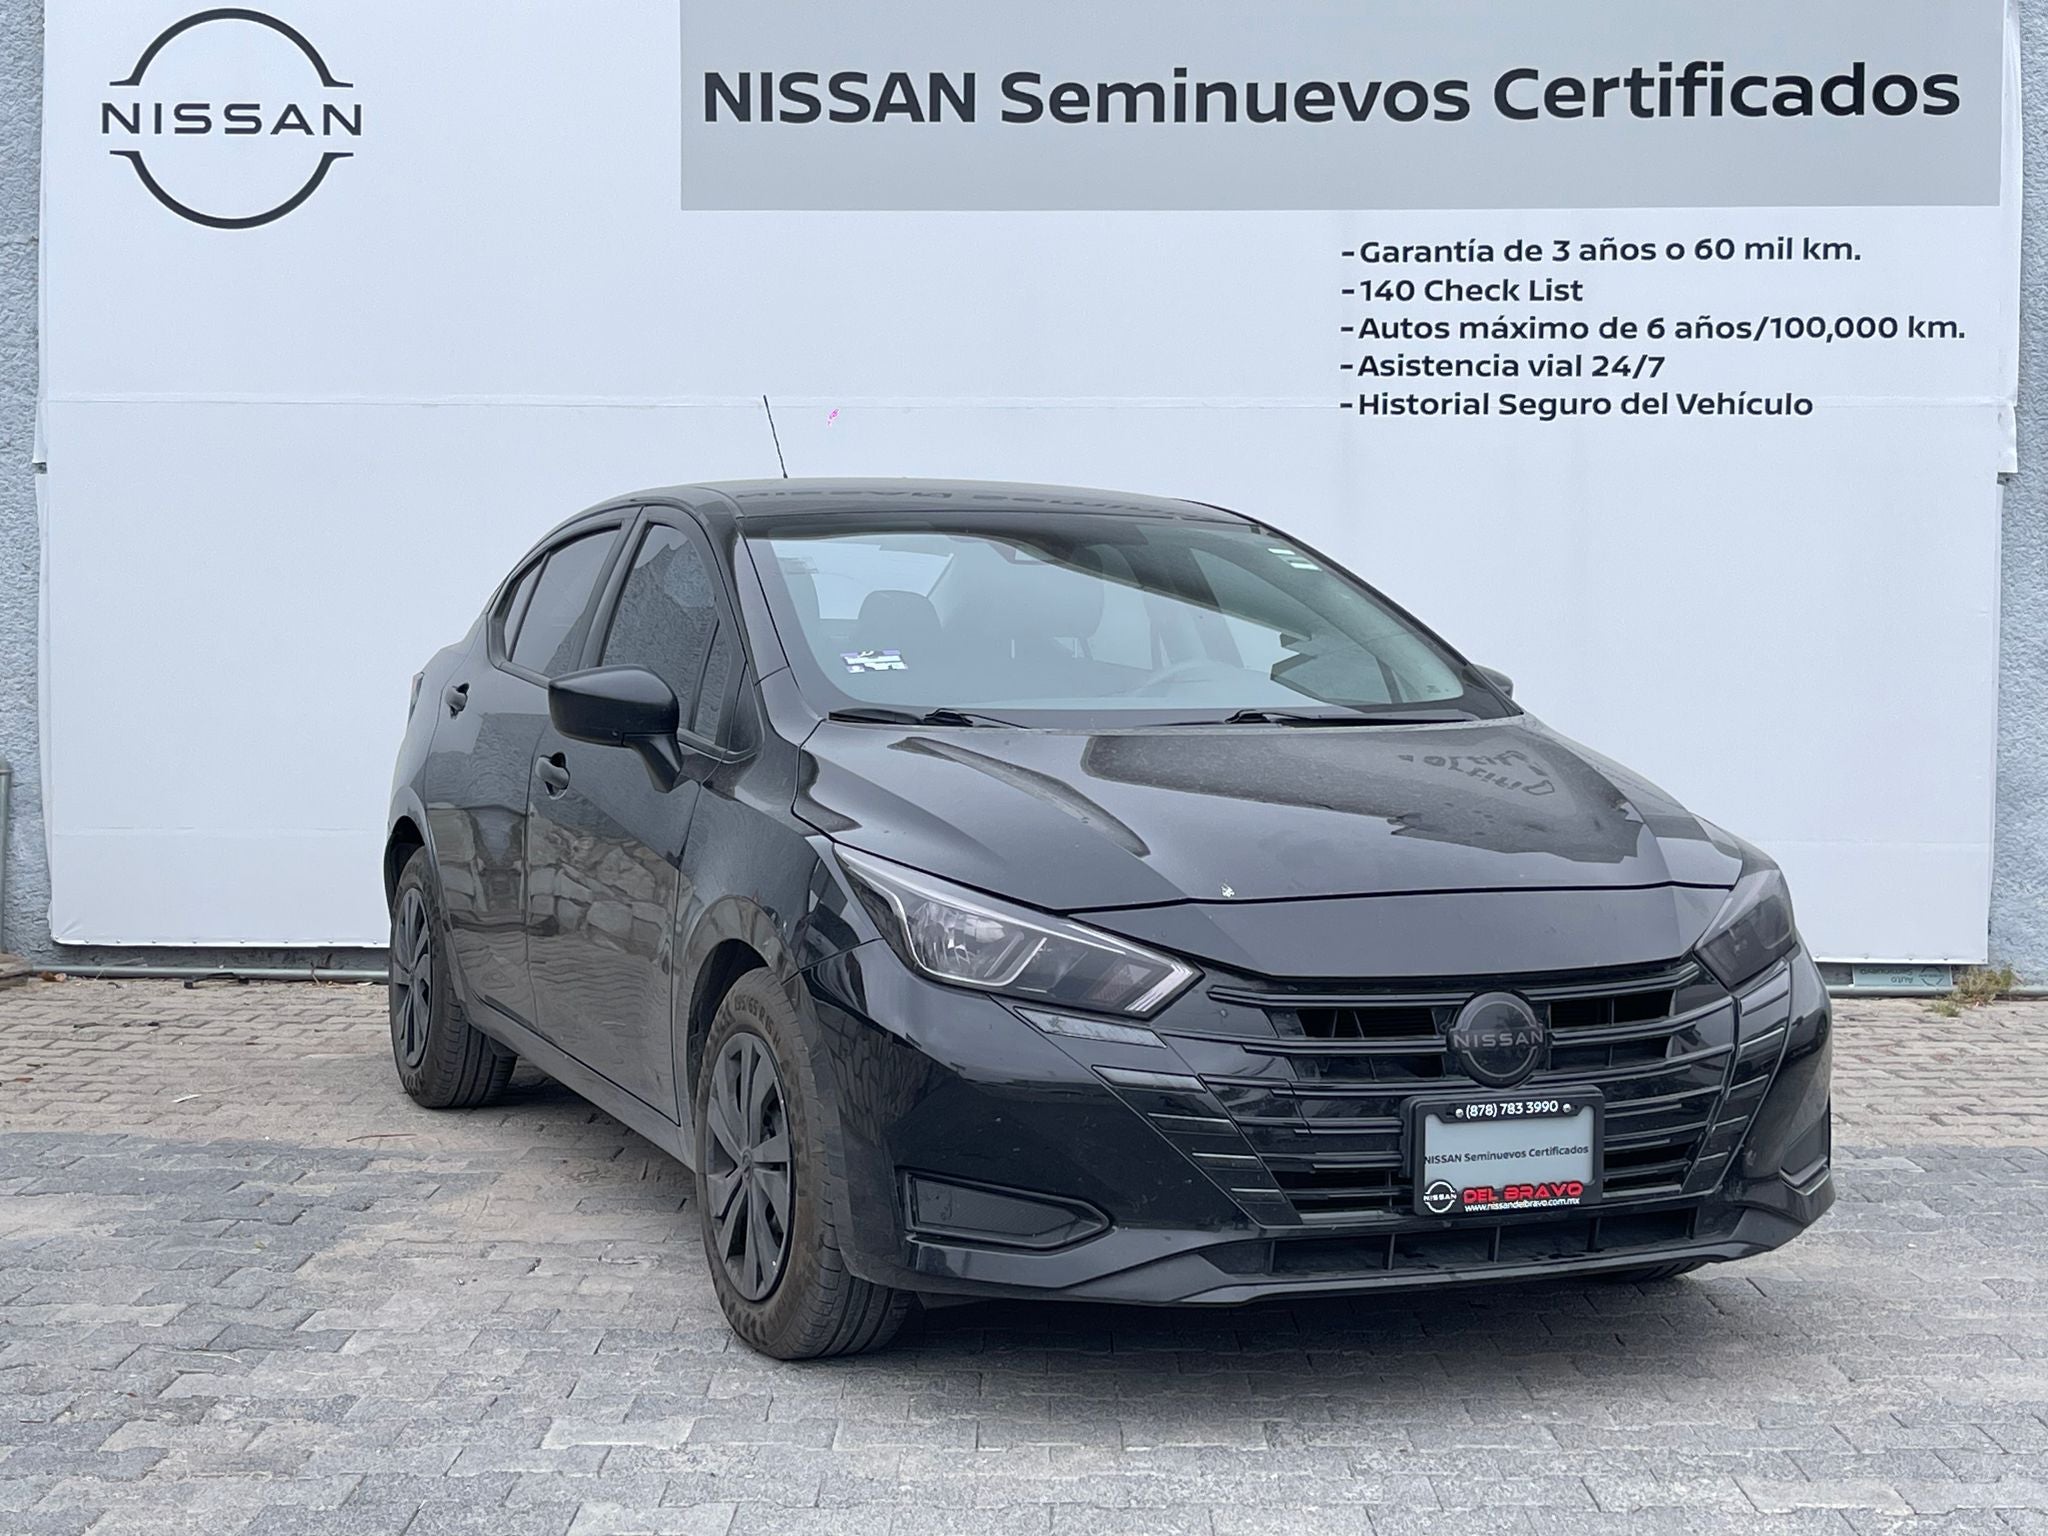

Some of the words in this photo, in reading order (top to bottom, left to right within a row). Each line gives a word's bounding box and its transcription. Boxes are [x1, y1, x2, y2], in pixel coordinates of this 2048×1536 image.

[704, 71, 976, 124] NISSAN
[1001, 67, 1470, 124] Seminuevos
[1494, 60, 1960, 120] Certificados
[102, 102, 362, 136] NISSAN
[1503, 239, 1543, 262] de
[1552, 240, 1570, 262] 3
[1579, 236, 1657, 262] años
[1665, 242, 1685, 261] o
[1694, 238, 1735, 260] 60
[1745, 236, 1793, 260] mil
[1803, 237, 1861, 261] km.
[1424, 278, 1520, 302] Check
[1529, 277, 1584, 302] List
[1459, 314, 1589, 340] máximo
[1598, 316, 1638, 340] de
[1647, 317, 1666, 339] 6
[1674, 315, 1898, 343] años/100,000
[1908, 315, 1965, 339] km.
[1527, 353, 1582, 377] vial
[1591, 354, 1666, 380] 24/7
[1498, 393, 1612, 422] Seguro
[1620, 391, 1668, 415] del
[1675, 390, 1813, 416] Vehículo
[1453, 1031, 1544, 1048] NISSAN
[1466, 1104, 1498, 1119] (878)
[1500, 1103, 1523, 1115] 783
[1526, 1100, 1559, 1114] 3990
[1425, 1153, 1462, 1165] NISSAN
[1464, 1147, 1527, 1162] Seminuevos
[1528, 1144, 1589, 1158] Certificados
[1423, 1193, 1458, 1201] NISSAN
[1463, 1189, 1499, 1204] DEL
[1503, 1180, 1583, 1200] BRAVO
